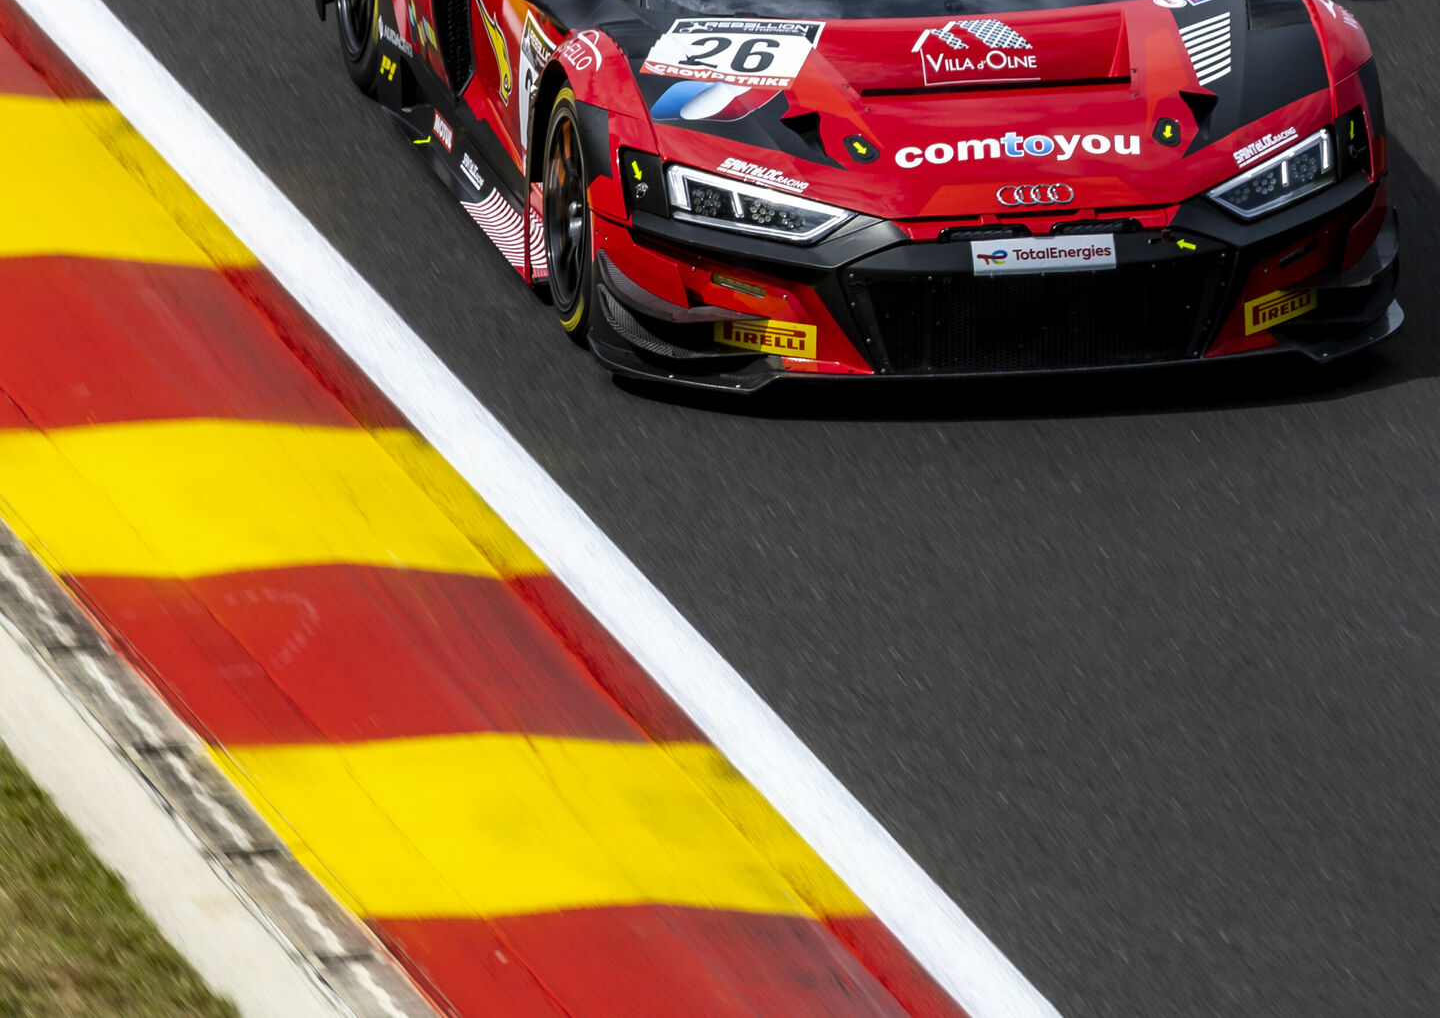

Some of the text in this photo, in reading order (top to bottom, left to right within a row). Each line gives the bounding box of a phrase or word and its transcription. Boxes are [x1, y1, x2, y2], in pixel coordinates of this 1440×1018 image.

[704, 22, 810, 33] REBELLION
[678, 36, 780, 73] 26
[655, 63, 791, 87] CROWDSTRIKE
[895, 132, 1141, 169] comtoyou
[1013, 244, 1112, 262] TotalEnergies
[1252, 289, 1312, 326] PIRELLI
[723, 321, 806, 351] PIRELLI
